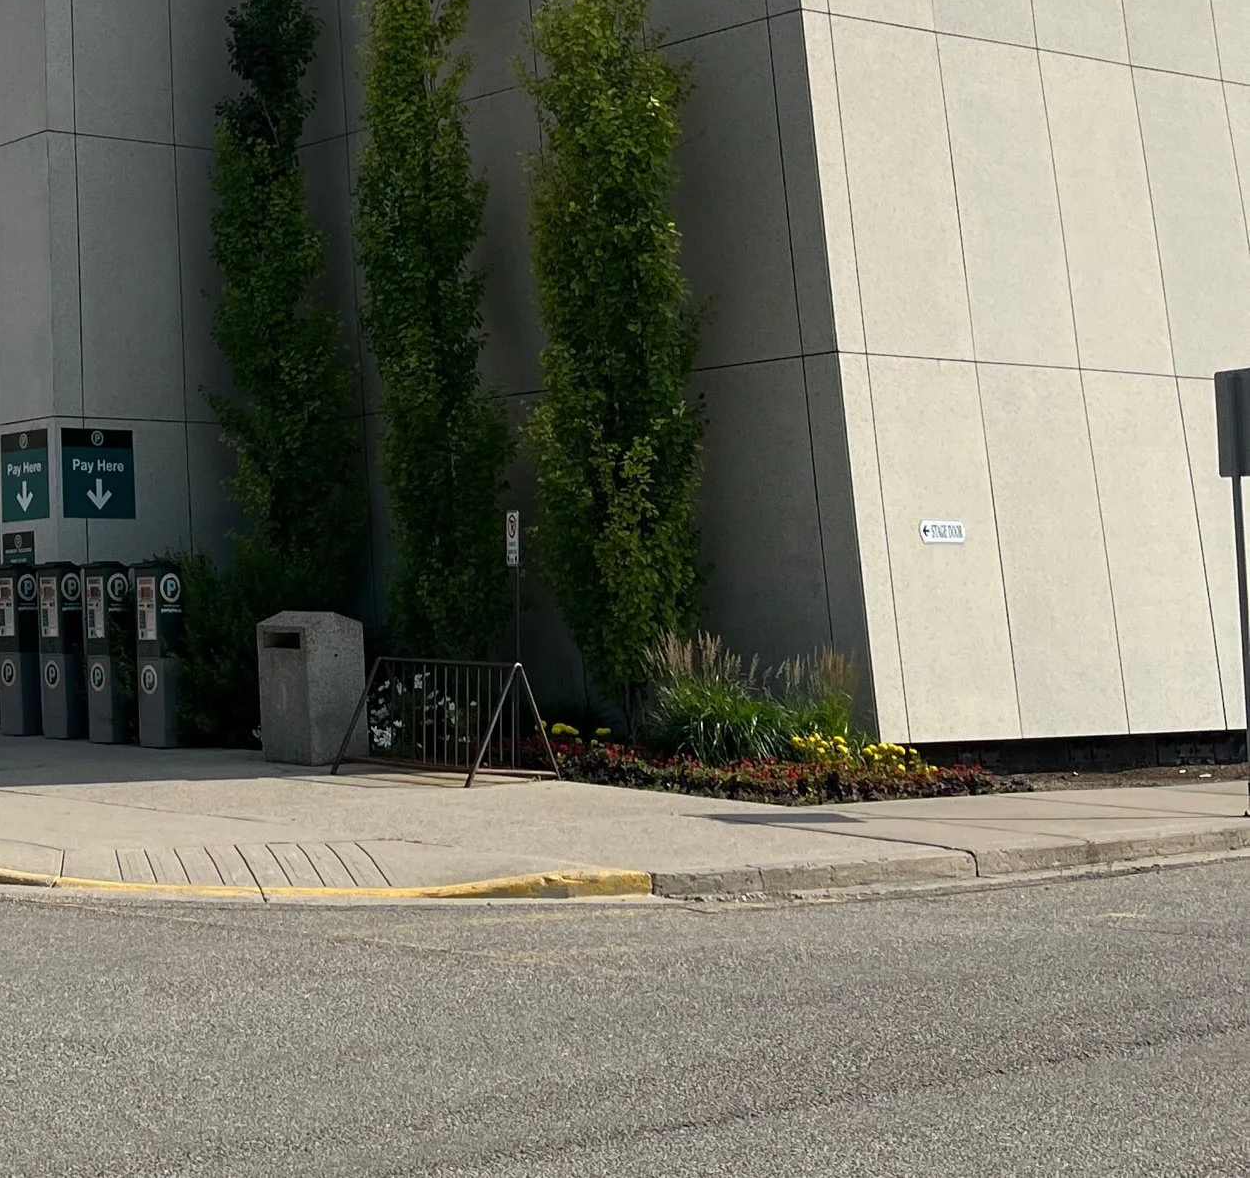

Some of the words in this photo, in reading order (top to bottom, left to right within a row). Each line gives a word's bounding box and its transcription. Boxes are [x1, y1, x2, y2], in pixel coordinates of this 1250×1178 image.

[7, 463, 21, 477] Pay
[23, 462, 42, 474] Here
[72, 458, 94, 474] Pay
[97, 459, 125, 472] Here
[931, 525, 948, 538] STAGE
[948, 524, 964, 538] DOOR
